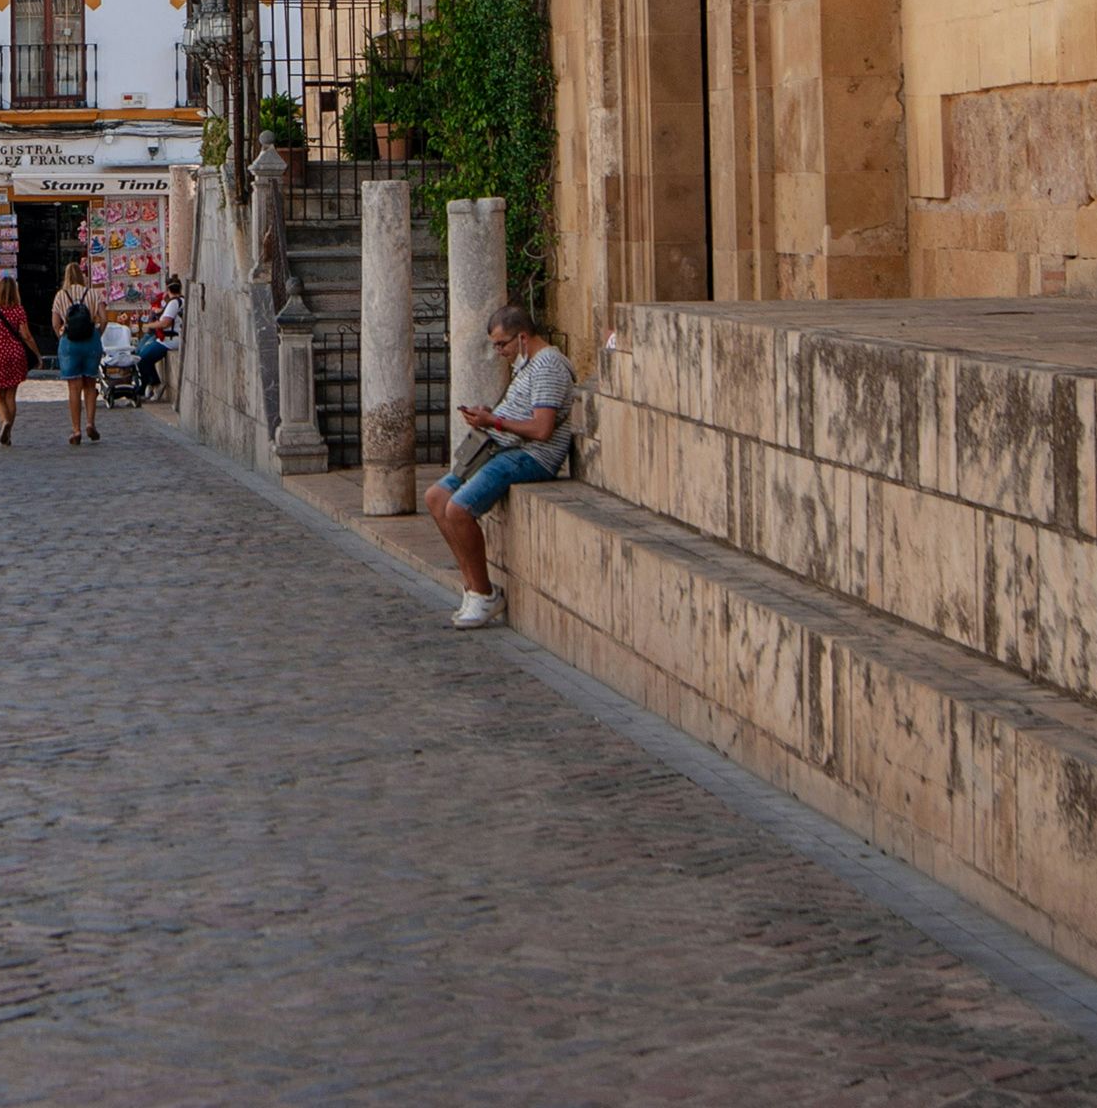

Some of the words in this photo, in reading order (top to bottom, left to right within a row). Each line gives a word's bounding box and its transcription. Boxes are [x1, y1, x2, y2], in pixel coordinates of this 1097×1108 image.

[29, 155, 95, 165] FRANCES
[40, 179, 104, 193] Stamp
[117, 179, 170, 191] Timb
